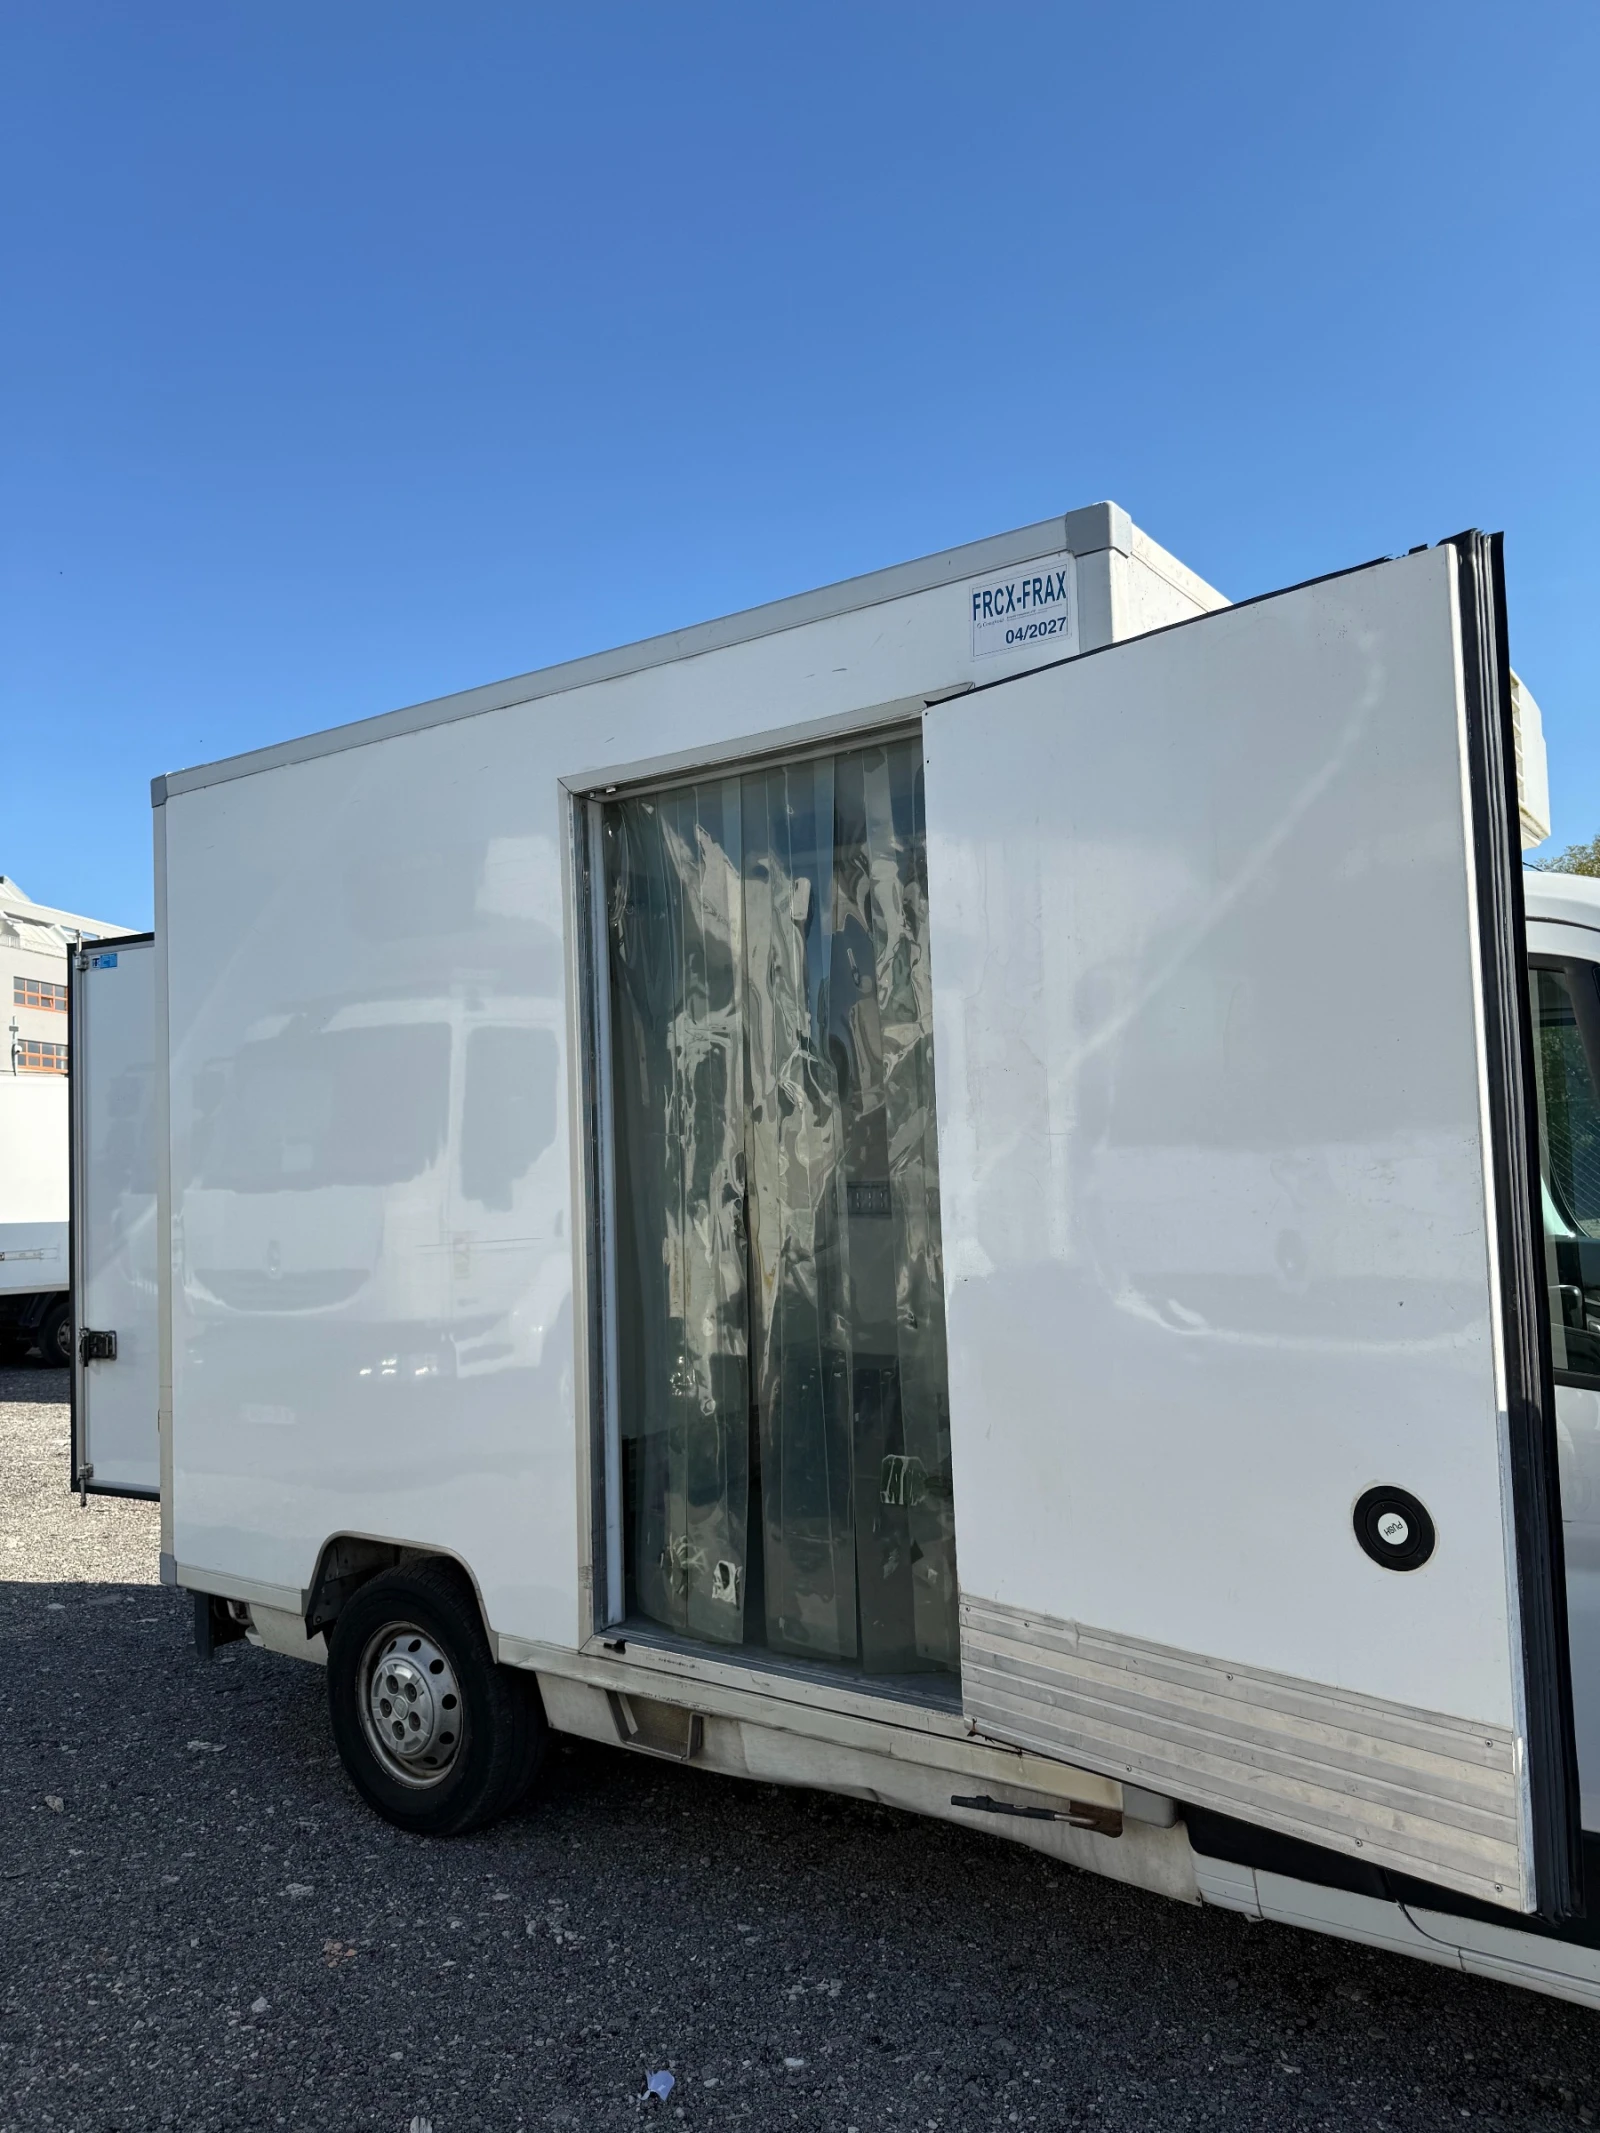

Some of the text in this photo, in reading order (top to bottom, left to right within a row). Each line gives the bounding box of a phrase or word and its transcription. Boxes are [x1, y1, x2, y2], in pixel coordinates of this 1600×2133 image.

[973, 571, 1066, 621] FRCX-FRAX
[1005, 617, 1066, 644] 04/2027
[1384, 1521, 1403, 1536] PUSH
